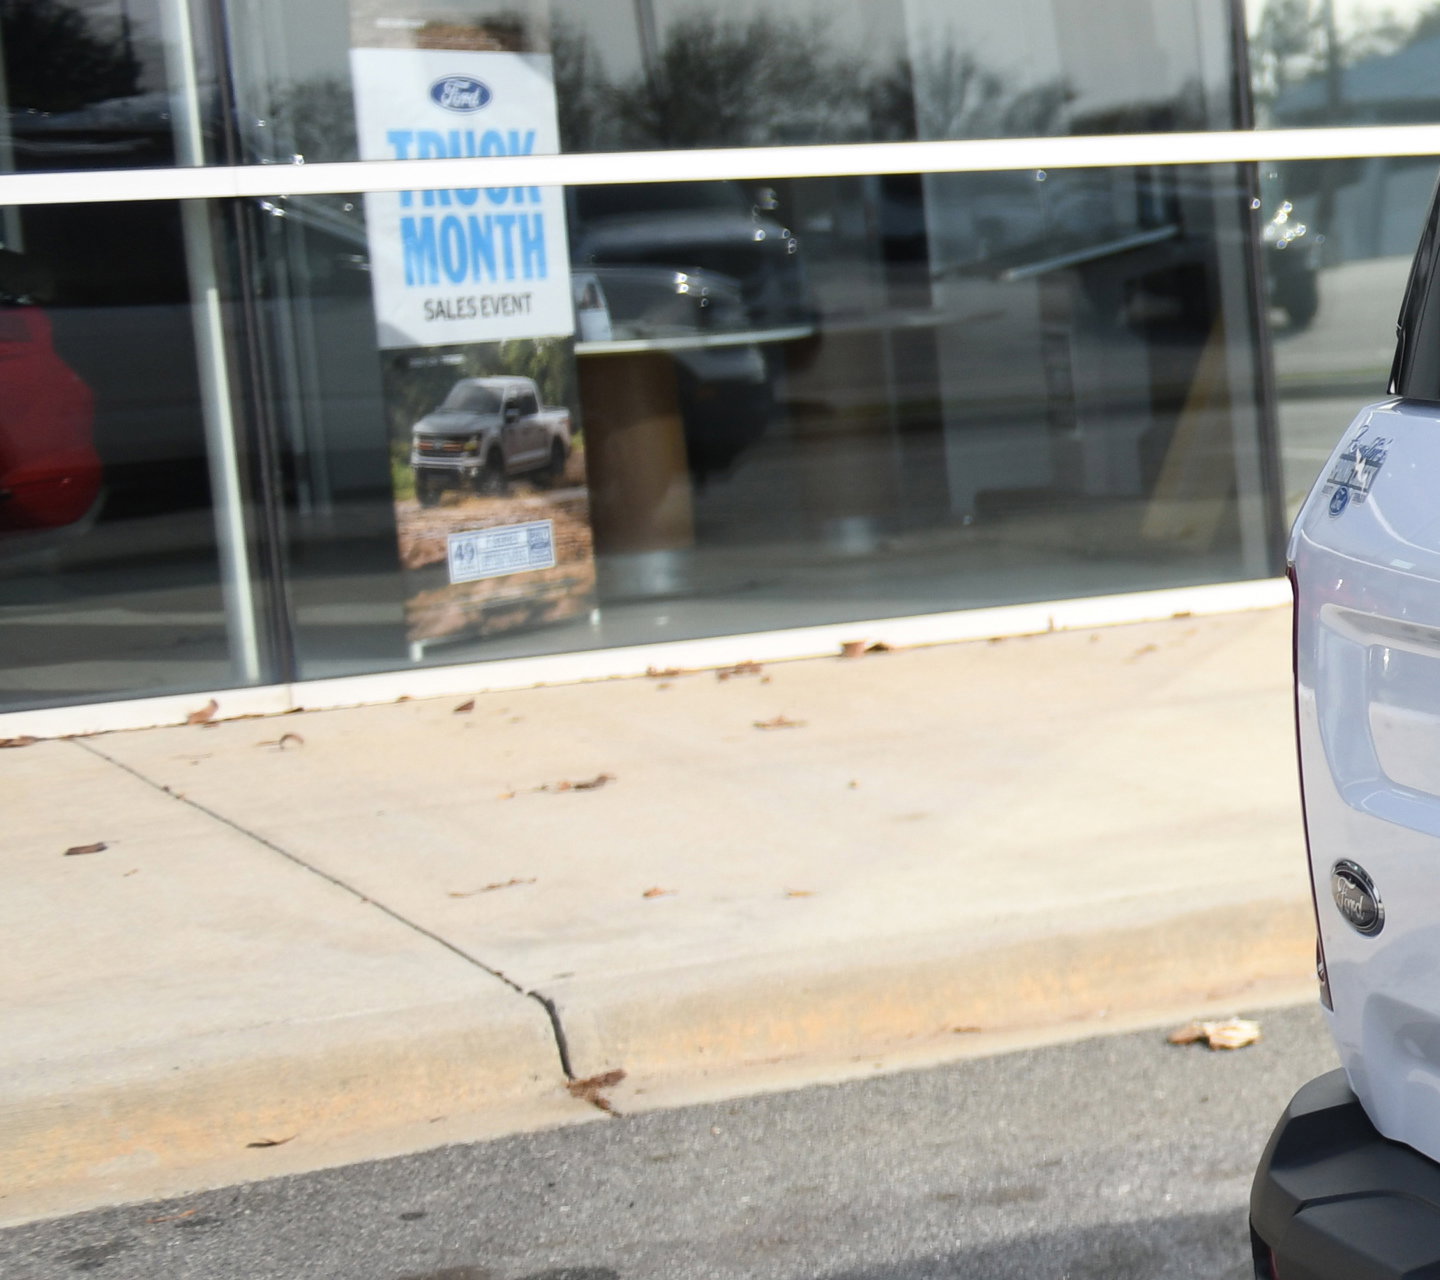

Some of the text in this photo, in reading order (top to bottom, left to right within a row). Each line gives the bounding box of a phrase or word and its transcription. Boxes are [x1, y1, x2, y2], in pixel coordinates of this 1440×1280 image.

[441, 78, 482, 109] Ford
[400, 212, 547, 288] MONTH
[423, 293, 533, 321] SALES EVENT
[1336, 876, 1365, 920] Ford
